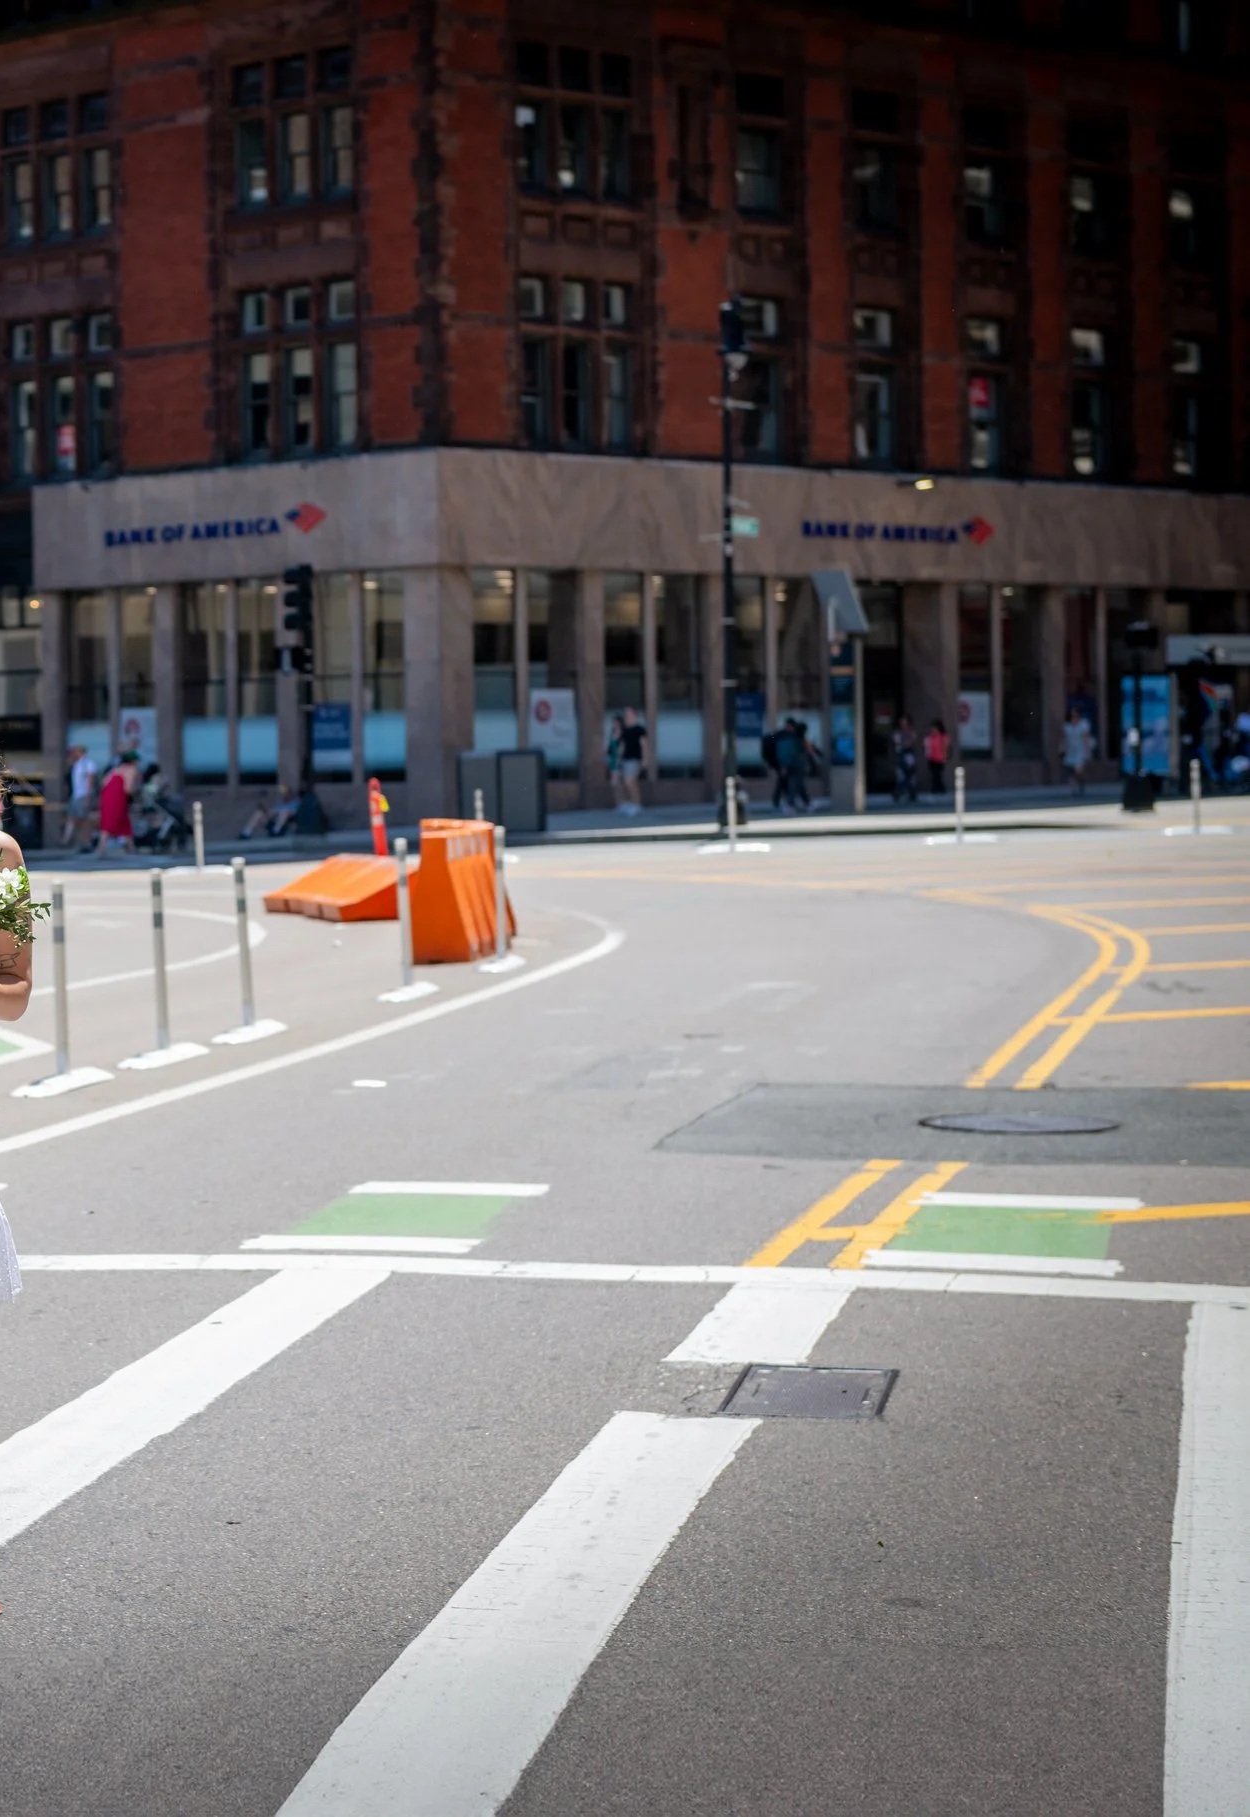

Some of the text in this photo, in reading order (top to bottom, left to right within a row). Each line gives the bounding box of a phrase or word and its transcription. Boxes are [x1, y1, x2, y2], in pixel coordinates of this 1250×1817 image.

[105, 517, 280, 547] BANK OF AMERICA
[802, 521, 957, 543] BANK OF AMERICA
